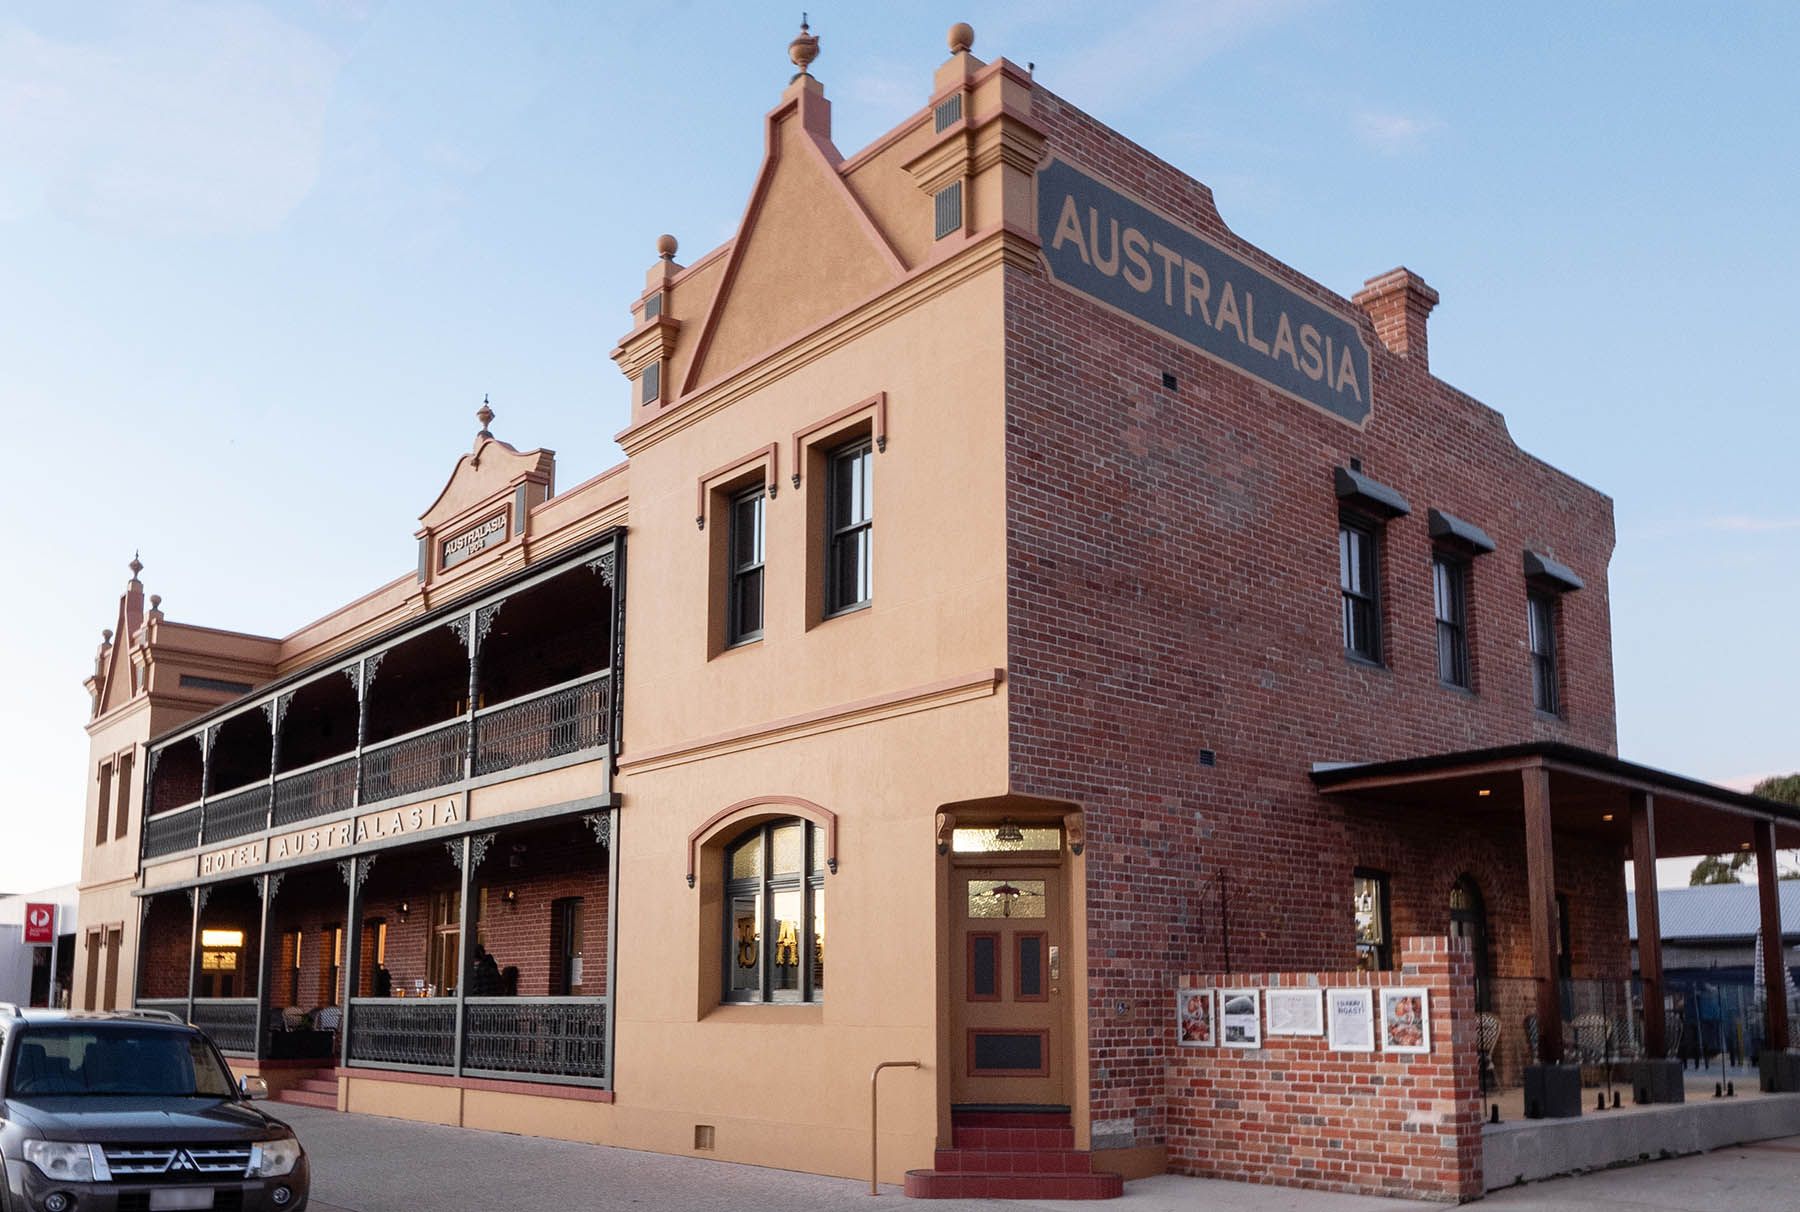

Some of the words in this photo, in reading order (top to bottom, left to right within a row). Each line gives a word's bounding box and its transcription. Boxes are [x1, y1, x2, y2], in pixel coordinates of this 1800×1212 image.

[1052, 194, 1362, 402] AUSTRALASIA
[445, 515, 506, 556] AUSTRALASIA
[204, 845, 260, 873] HOTEL
[279, 800, 459, 858] AUSTRALASIA
